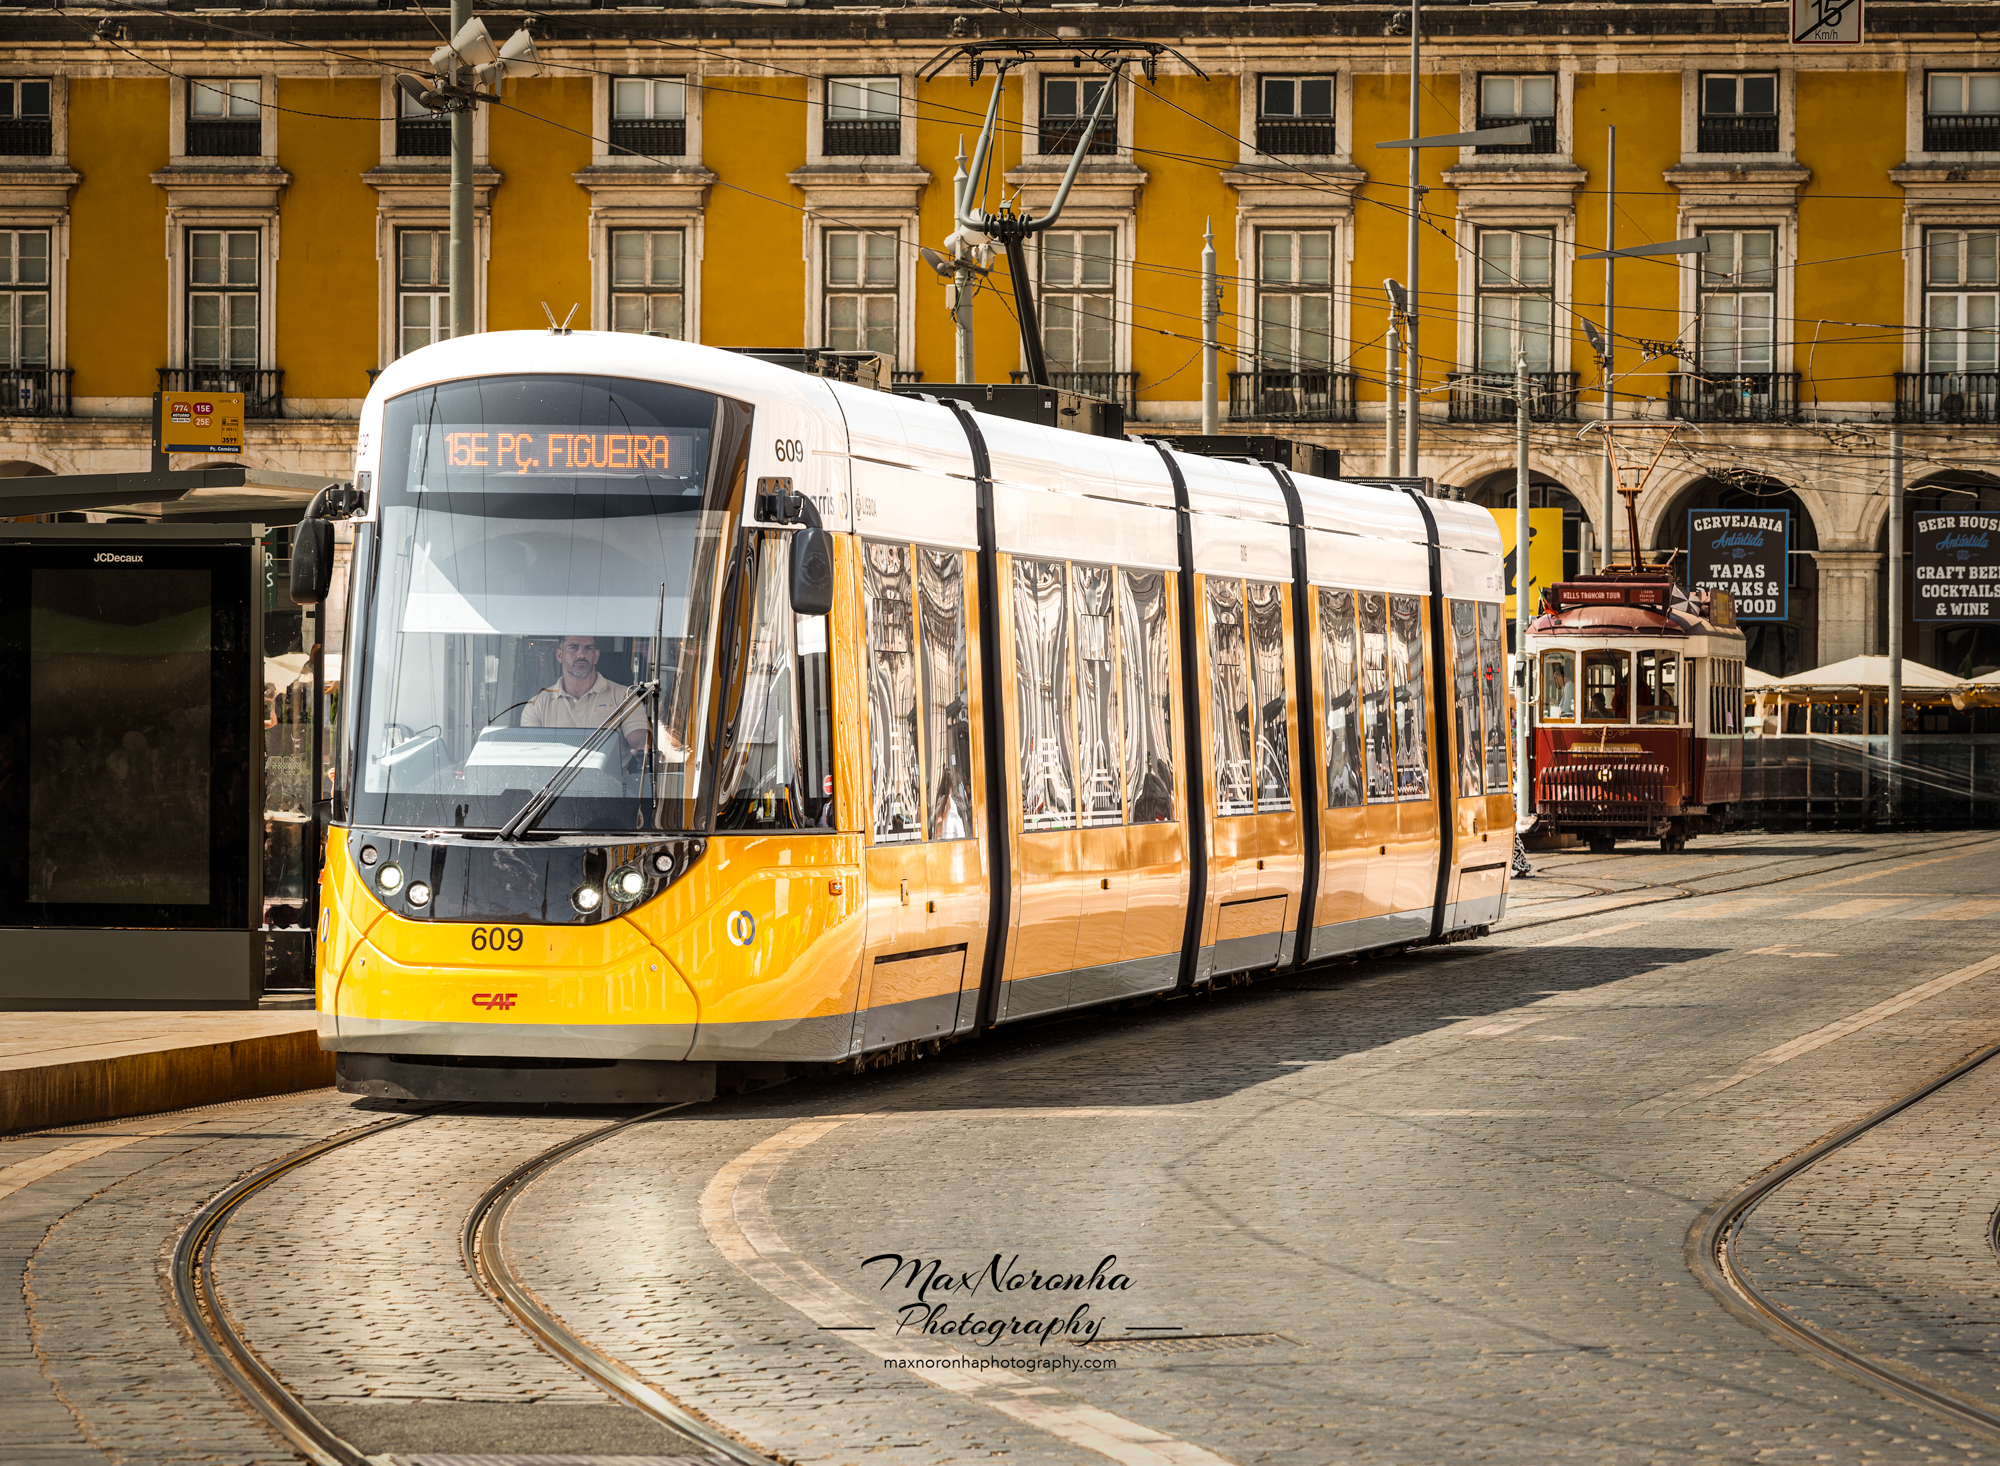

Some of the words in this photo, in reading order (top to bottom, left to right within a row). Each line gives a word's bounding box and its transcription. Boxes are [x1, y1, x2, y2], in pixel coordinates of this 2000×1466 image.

[1814, 29, 1838, 40] Km/h
[174, 404, 188, 412] 774
[196, 404, 211, 412] 15E
[196, 418, 210, 426] 25E
[445, 432, 488, 466] 15E
[498, 433, 539, 474] PÇ.
[548, 434, 669, 468] FIGUEIRA
[775, 438, 803, 462] 609
[1694, 515, 1783, 532] CERVEJARIA
[1918, 516, 1956, 533] BEER
[1711, 530, 1765, 549] Antártida
[1936, 532, 1989, 551] Antártida
[93, 552, 144, 563] JCDecaux
[1710, 564, 1765, 579] TAPAS
[1916, 566, 1966, 579] CRAFT
[1968, 566, 2000, 579] BEE
[1581, 591, 1605, 599] TRAMCAR
[1606, 591, 1621, 599] TOUR
[1767, 582, 1779, 596] &
[1935, 603, 1947, 616] &
[1950, 603, 1989, 616] WINE
[471, 926, 524, 952] 609
[471, 993, 518, 1011] CAF
